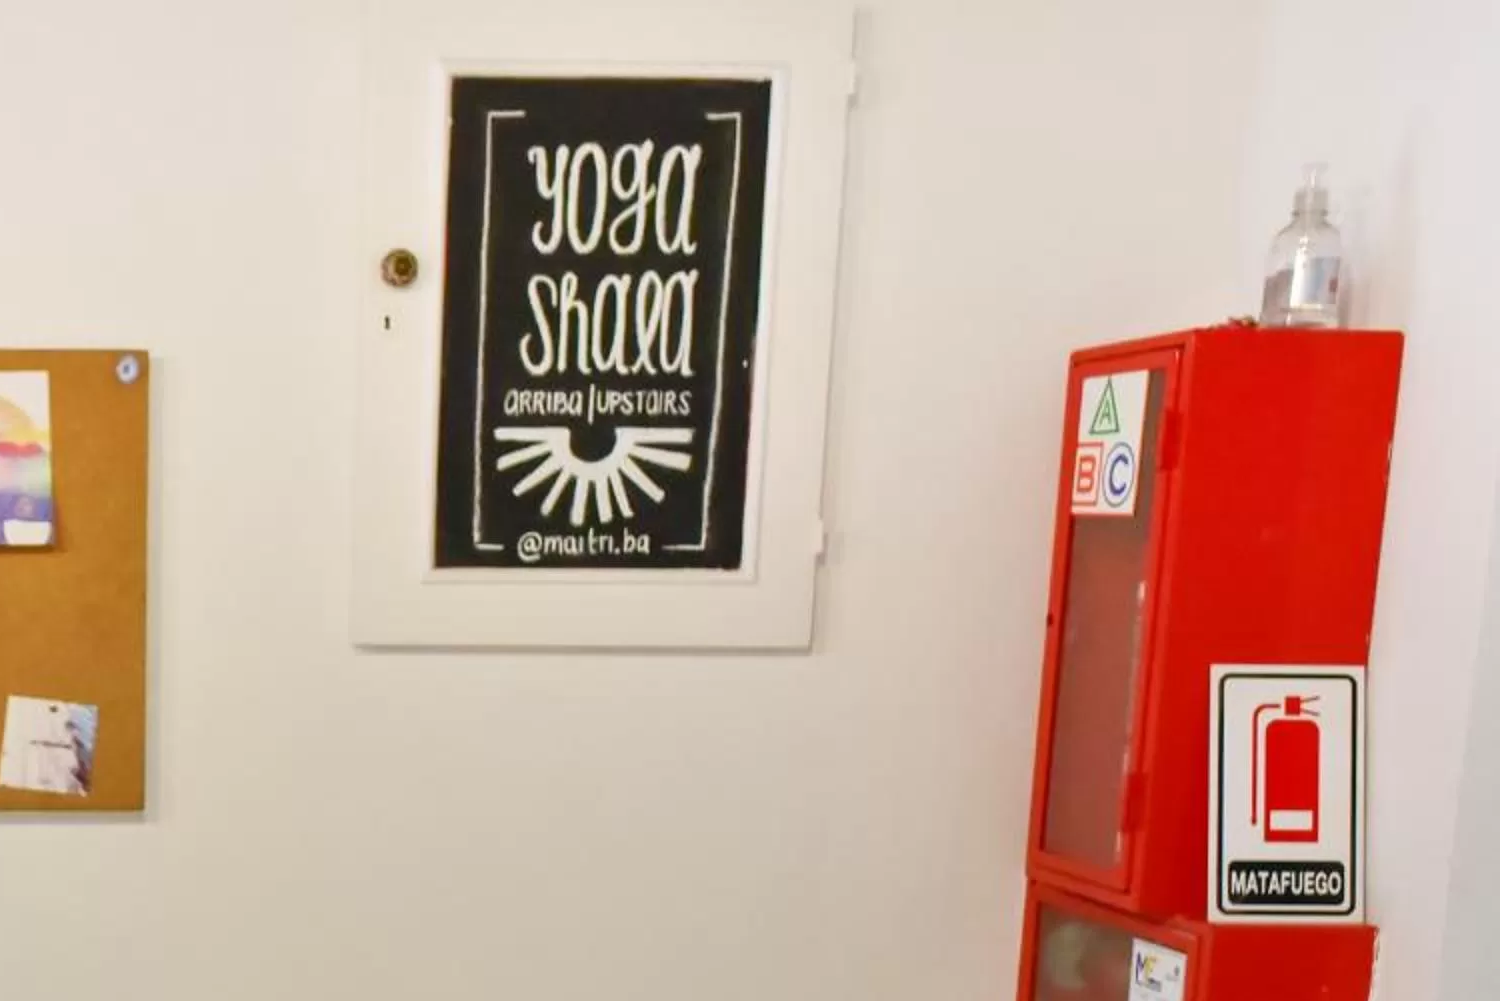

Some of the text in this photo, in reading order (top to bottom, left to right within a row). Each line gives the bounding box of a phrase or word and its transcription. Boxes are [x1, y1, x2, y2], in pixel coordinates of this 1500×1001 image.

[1100, 400, 1112, 422] A
[1076, 454, 1129, 495] B C
[518, 528, 650, 562] @maitri.ba
[1230, 871, 1342, 896] MATAFUEGO
